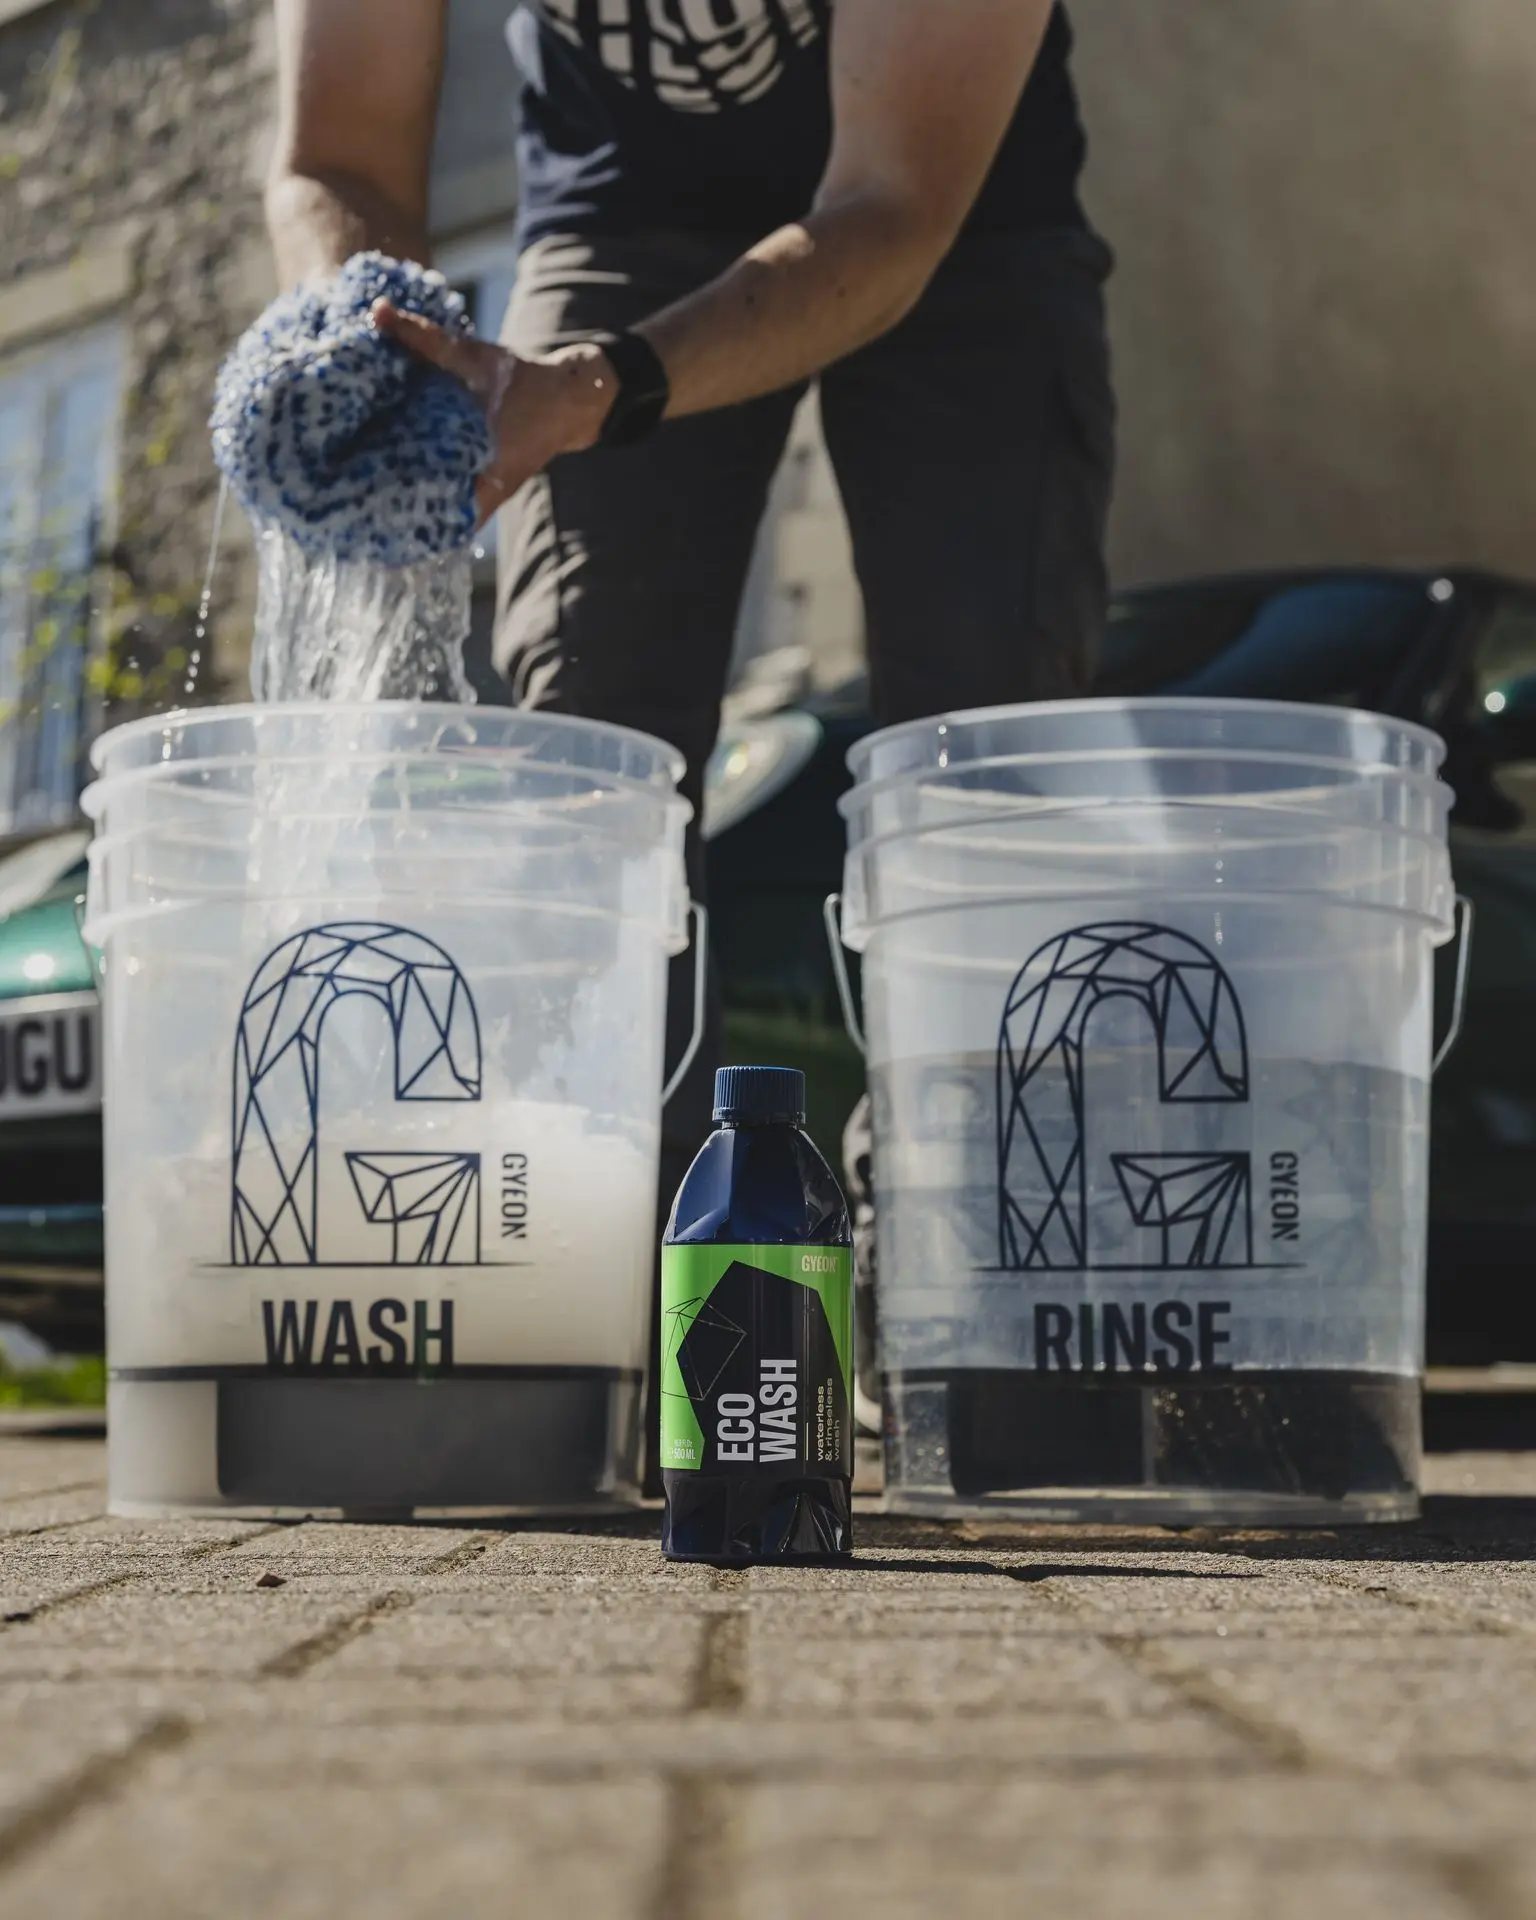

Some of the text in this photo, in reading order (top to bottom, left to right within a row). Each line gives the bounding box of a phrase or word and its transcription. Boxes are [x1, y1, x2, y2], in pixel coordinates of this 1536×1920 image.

[0, 1014, 92, 1097] GU
[502, 1153, 528, 1240] GYEON
[1269, 1151, 1299, 1241] GYEON
[801, 1255, 836, 1273] GYEON
[262, 1298, 454, 1378] WASH
[1034, 1300, 1232, 1374] RINSE
[717, 1393, 755, 1461] ECO
[759, 1359, 798, 1463] WASH
[816, 1386, 824, 1461] waterless
[825, 1450, 833, 1461] &
